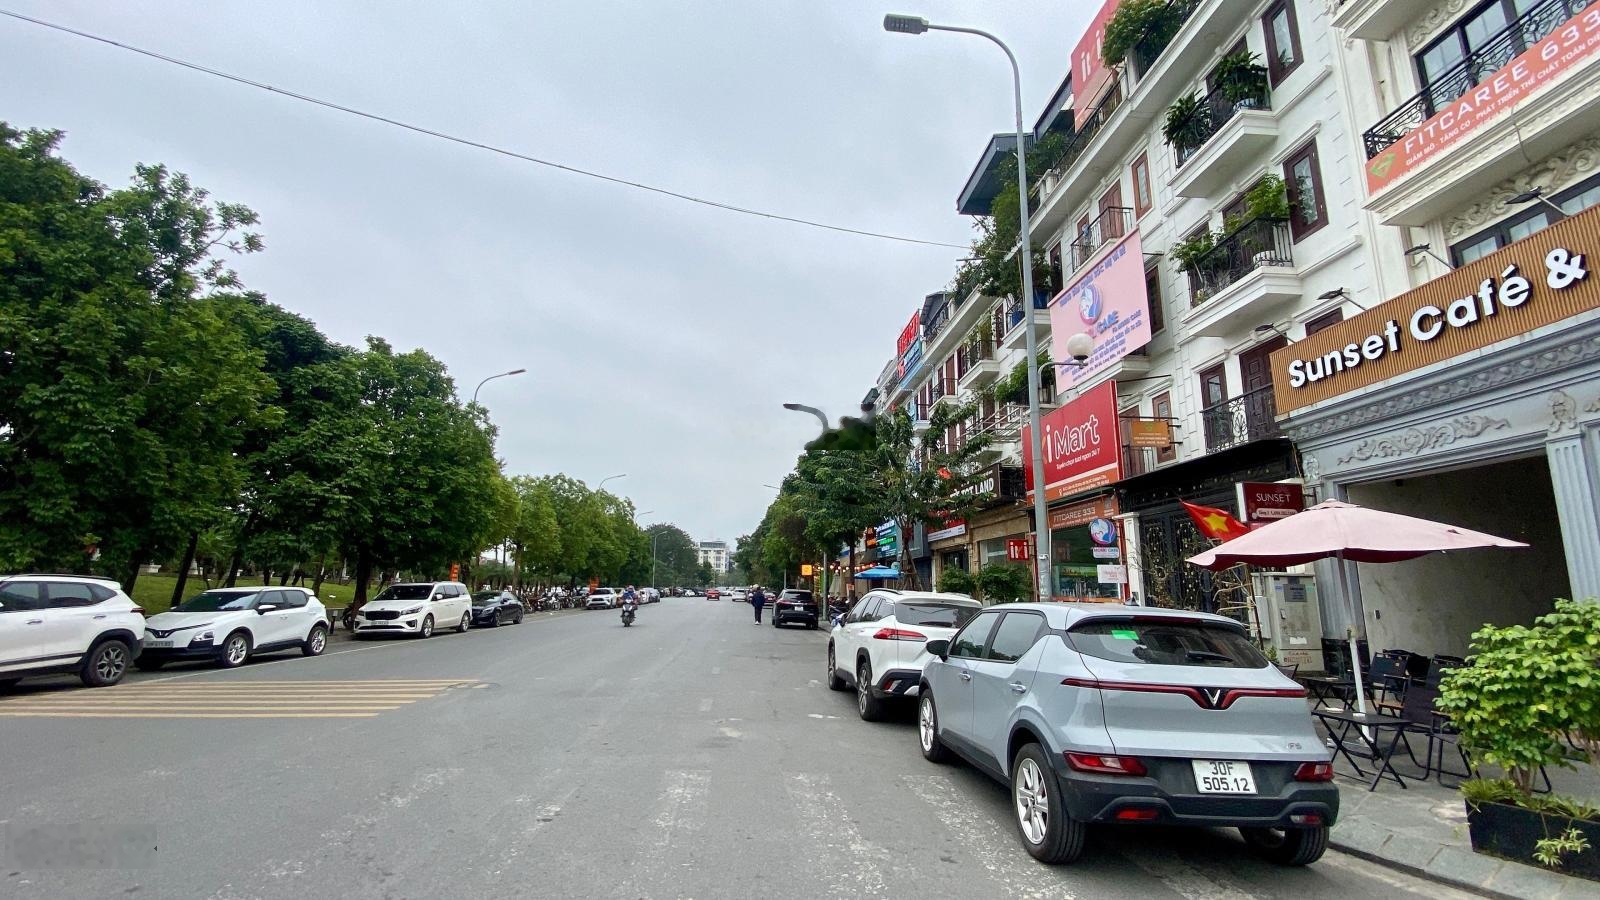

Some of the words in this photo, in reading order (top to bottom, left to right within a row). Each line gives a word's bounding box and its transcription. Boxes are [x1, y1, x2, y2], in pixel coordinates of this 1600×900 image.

[1405, 60, 1529, 154] FITCAREE
[1288, 320, 1400, 388] Sunset
[1409, 264, 1533, 342] Café
[1545, 248, 1590, 290] &
[1054, 414, 1100, 460] Mart
[974, 478, 994, 494] LAND
[1256, 493, 1291, 503] SUNSET
[1210, 762, 1234, 776] 30F
[1203, 777, 1250, 792] 505.12
